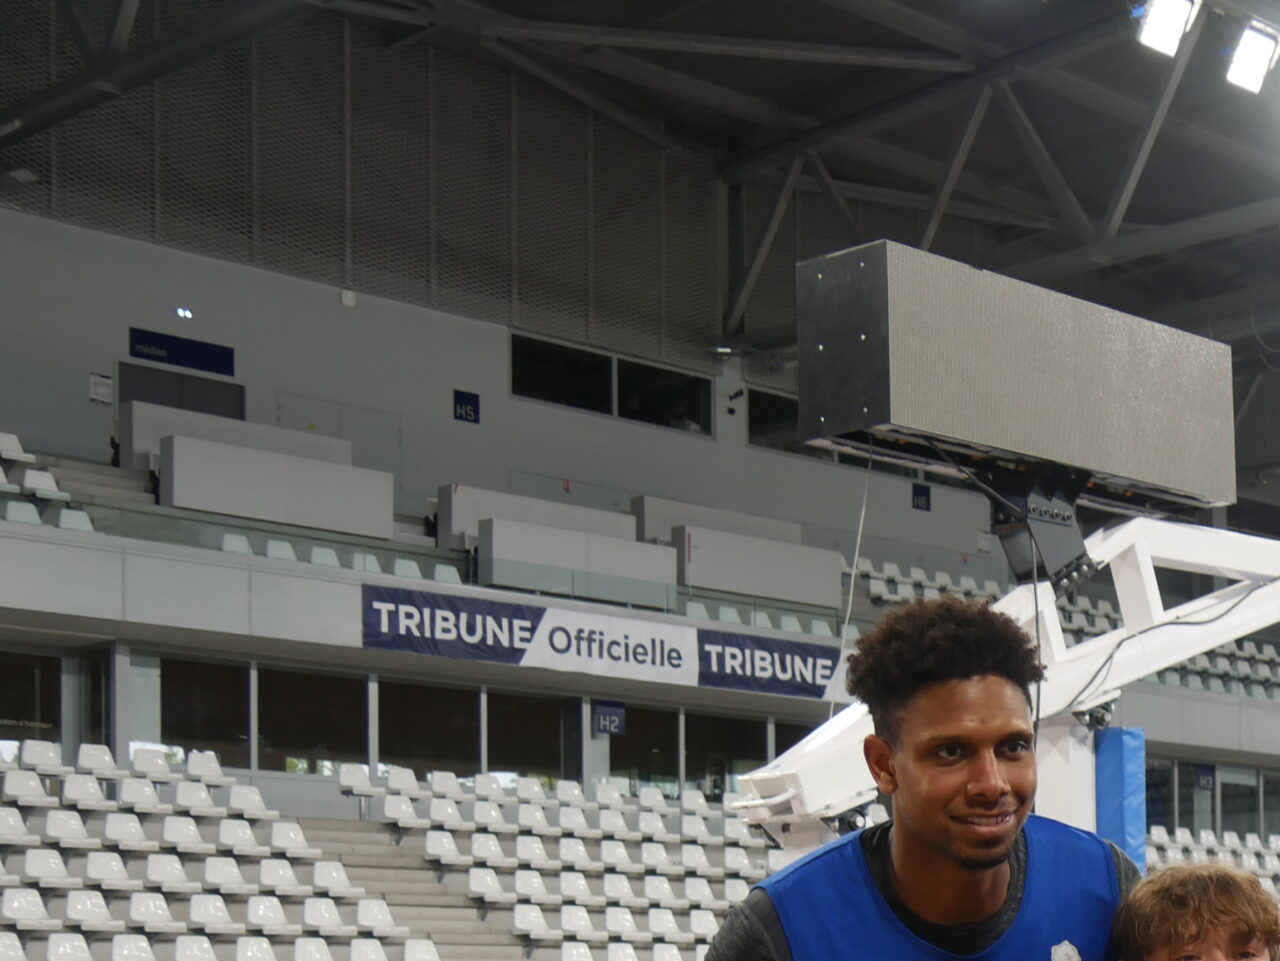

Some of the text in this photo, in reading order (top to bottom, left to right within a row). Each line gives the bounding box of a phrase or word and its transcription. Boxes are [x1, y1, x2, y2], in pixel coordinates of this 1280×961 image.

[456, 404, 475, 419] H5
[372, 601, 833, 685] TRIBUNE Officielle TRIBUNE
[600, 715, 619, 732] H2
